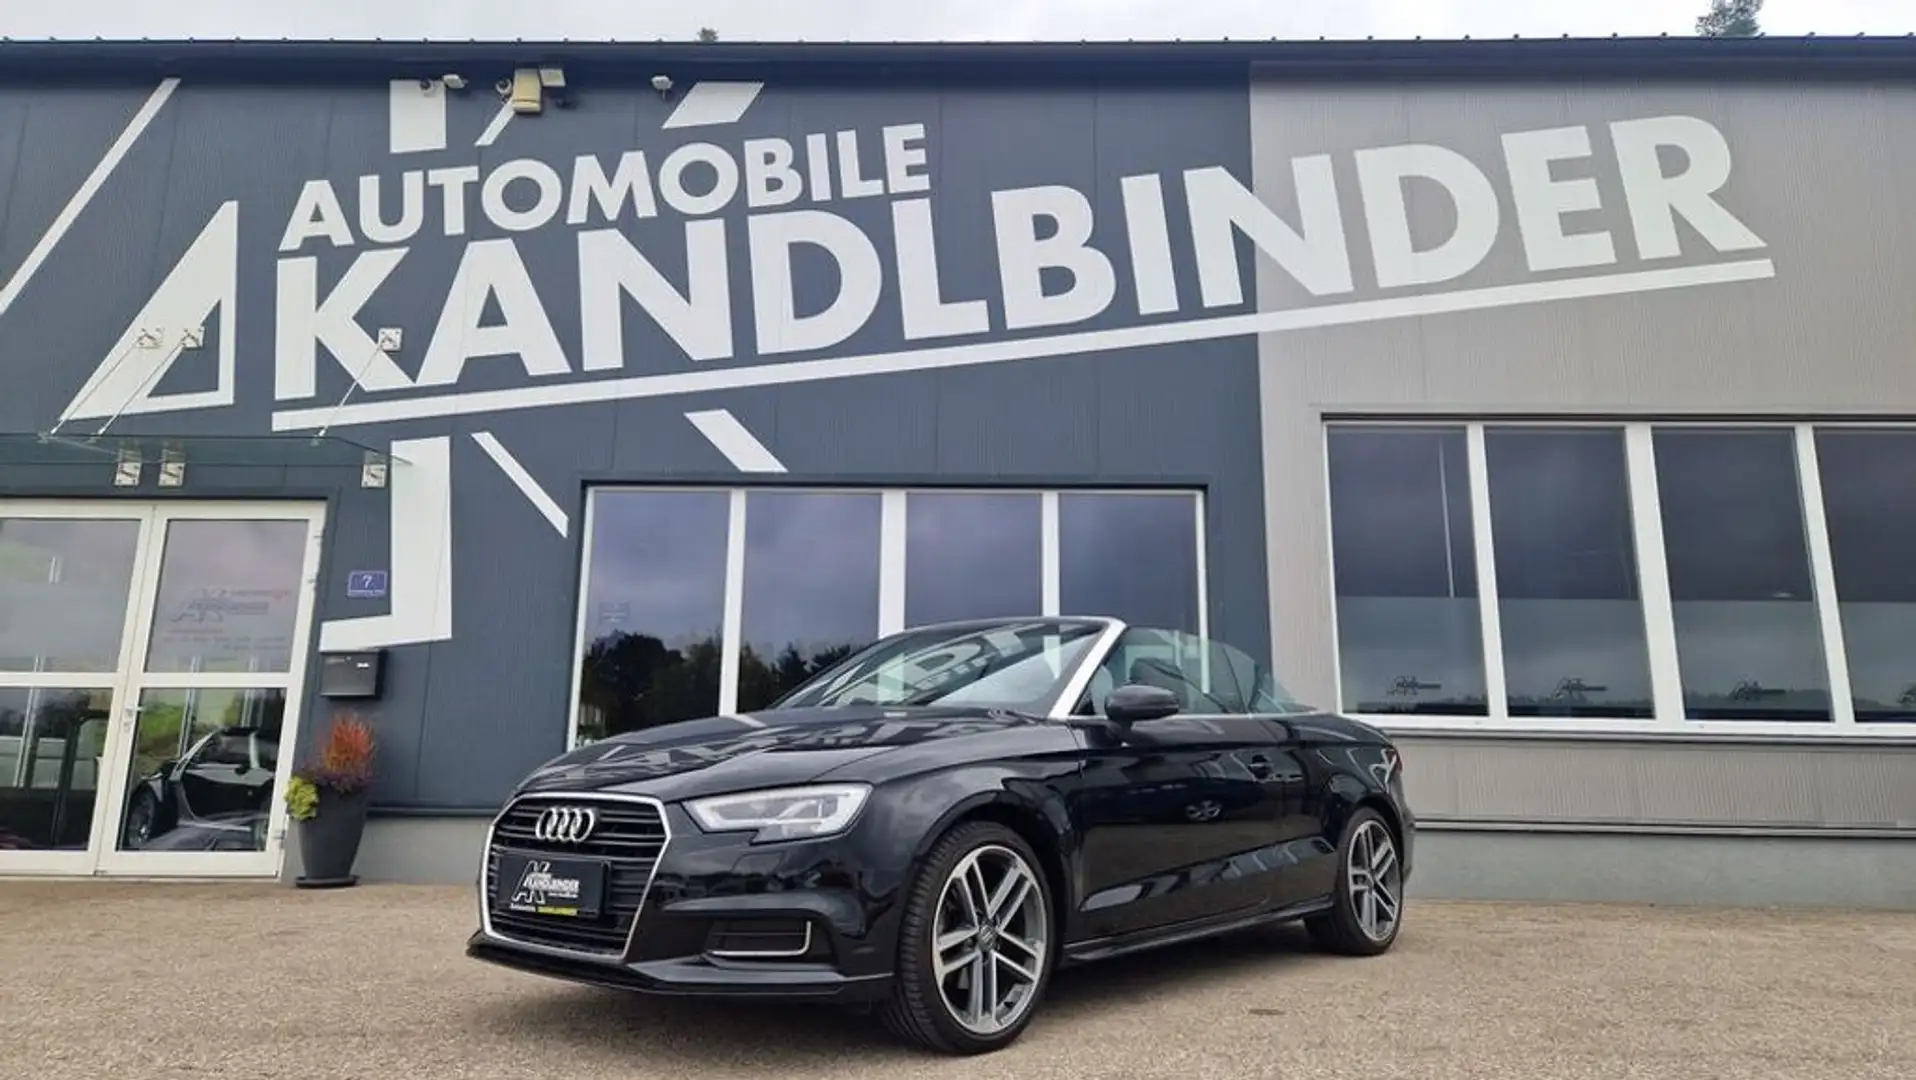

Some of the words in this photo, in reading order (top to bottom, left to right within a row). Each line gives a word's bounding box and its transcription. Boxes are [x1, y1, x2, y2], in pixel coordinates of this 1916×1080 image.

[279, 123, 930, 251] AUTOMOBILE
[275, 115, 1768, 400] KANDLBINDER
[363, 574, 373, 589] 7
